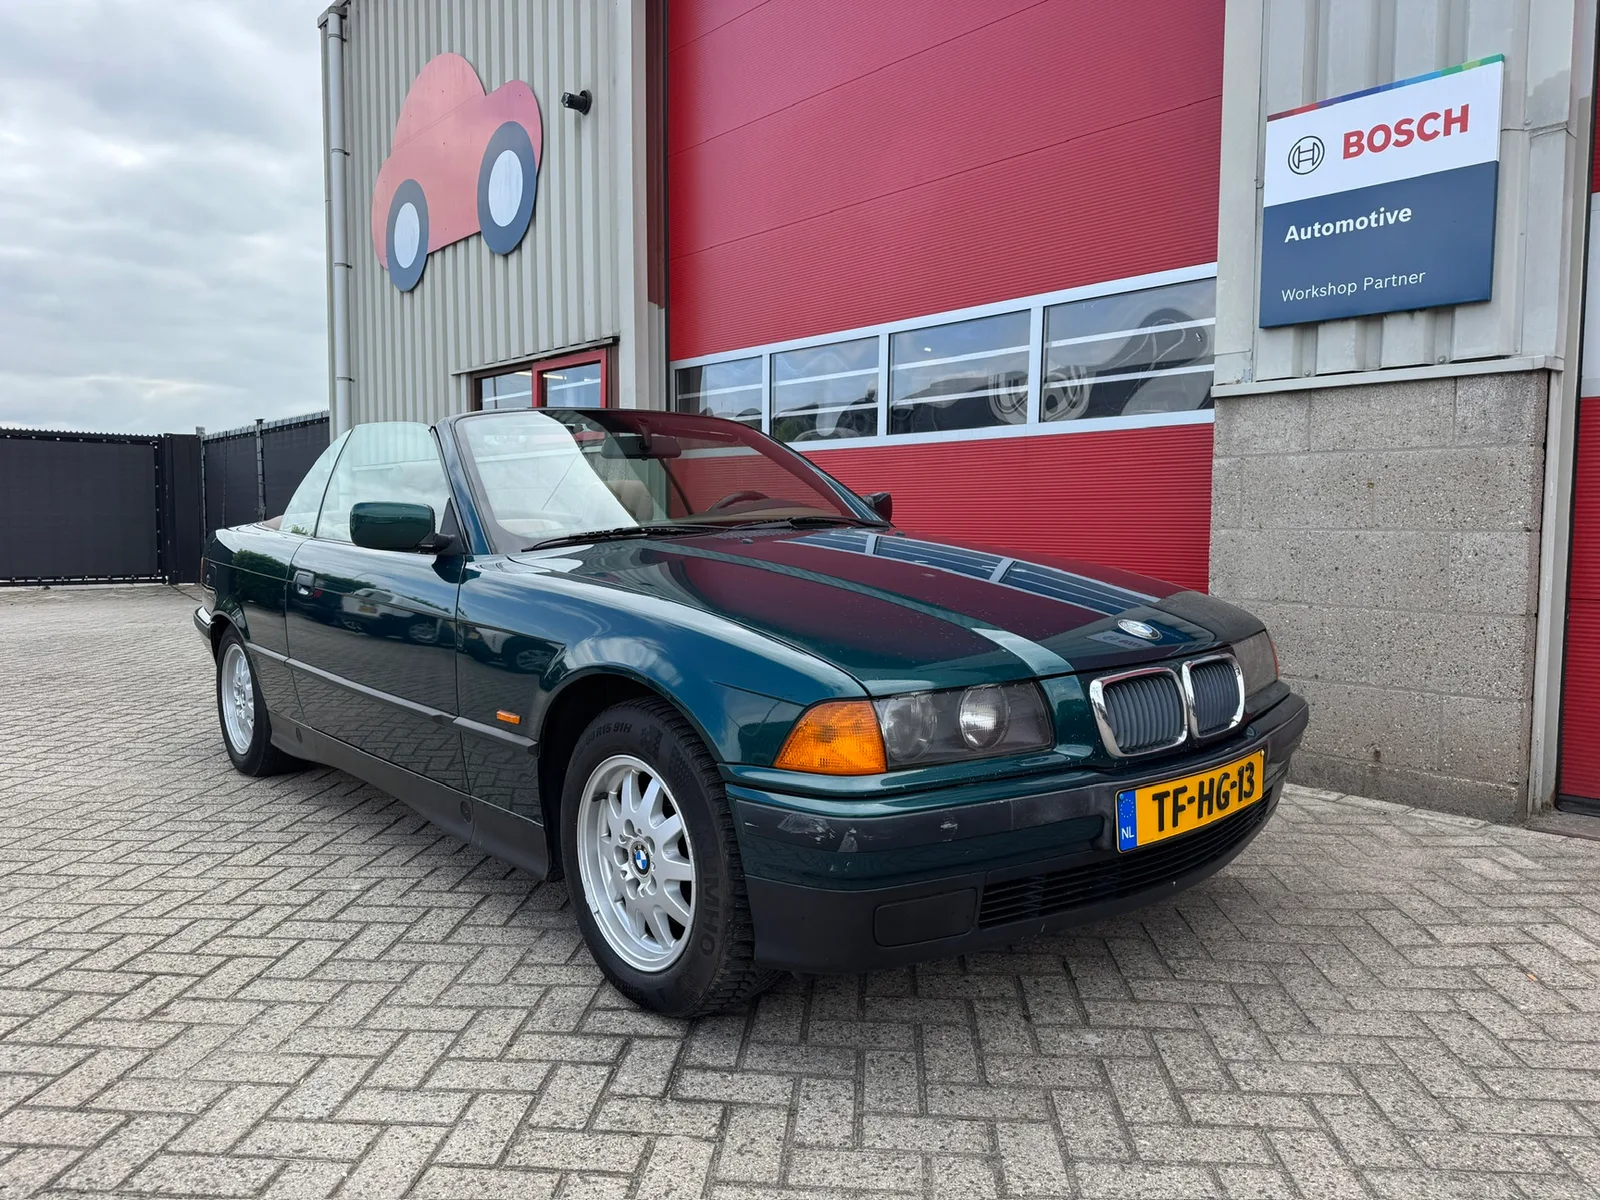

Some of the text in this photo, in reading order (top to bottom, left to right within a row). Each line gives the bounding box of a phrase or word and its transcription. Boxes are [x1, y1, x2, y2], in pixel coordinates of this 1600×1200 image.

[1342, 103, 1470, 160] BOSCH
[1284, 206, 1412, 243] Automotive
[1281, 271, 1426, 302] Workshop Partner
[612, 721, 634, 734] 91H
[1151, 761, 1255, 833] TF-HG-13
[1121, 826, 1135, 840] NL
